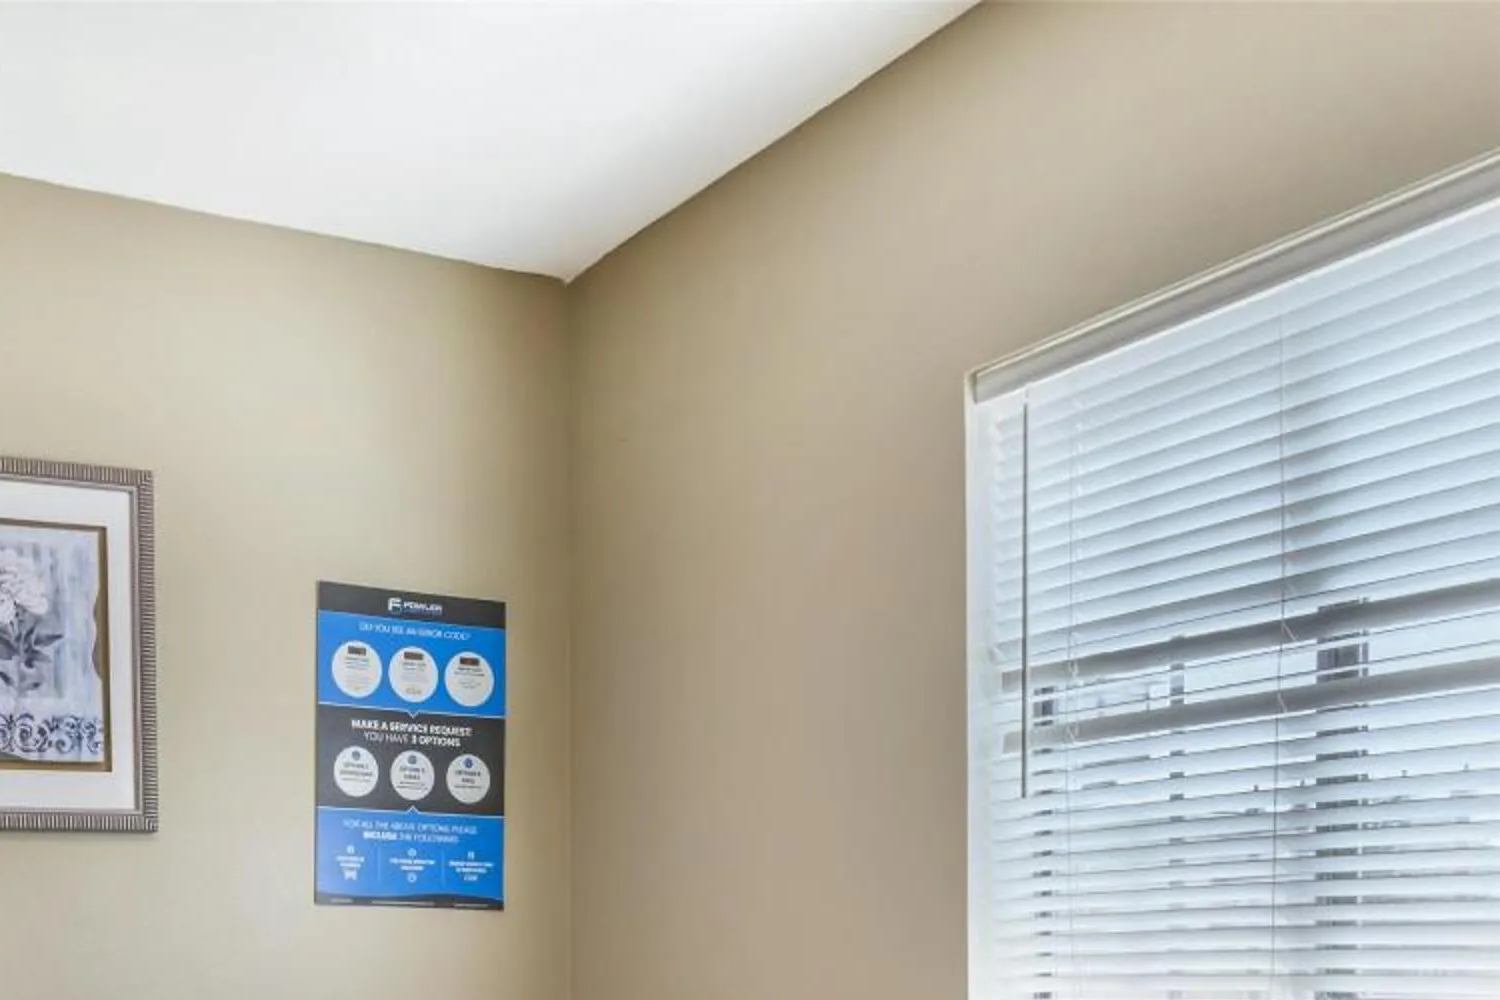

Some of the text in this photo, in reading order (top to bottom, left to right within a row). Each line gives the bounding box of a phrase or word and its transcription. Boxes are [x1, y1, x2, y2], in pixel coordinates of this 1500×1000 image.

[351, 719, 380, 731] MAKE
[381, 721, 389, 731] A
[363, 732, 384, 743] YOU
